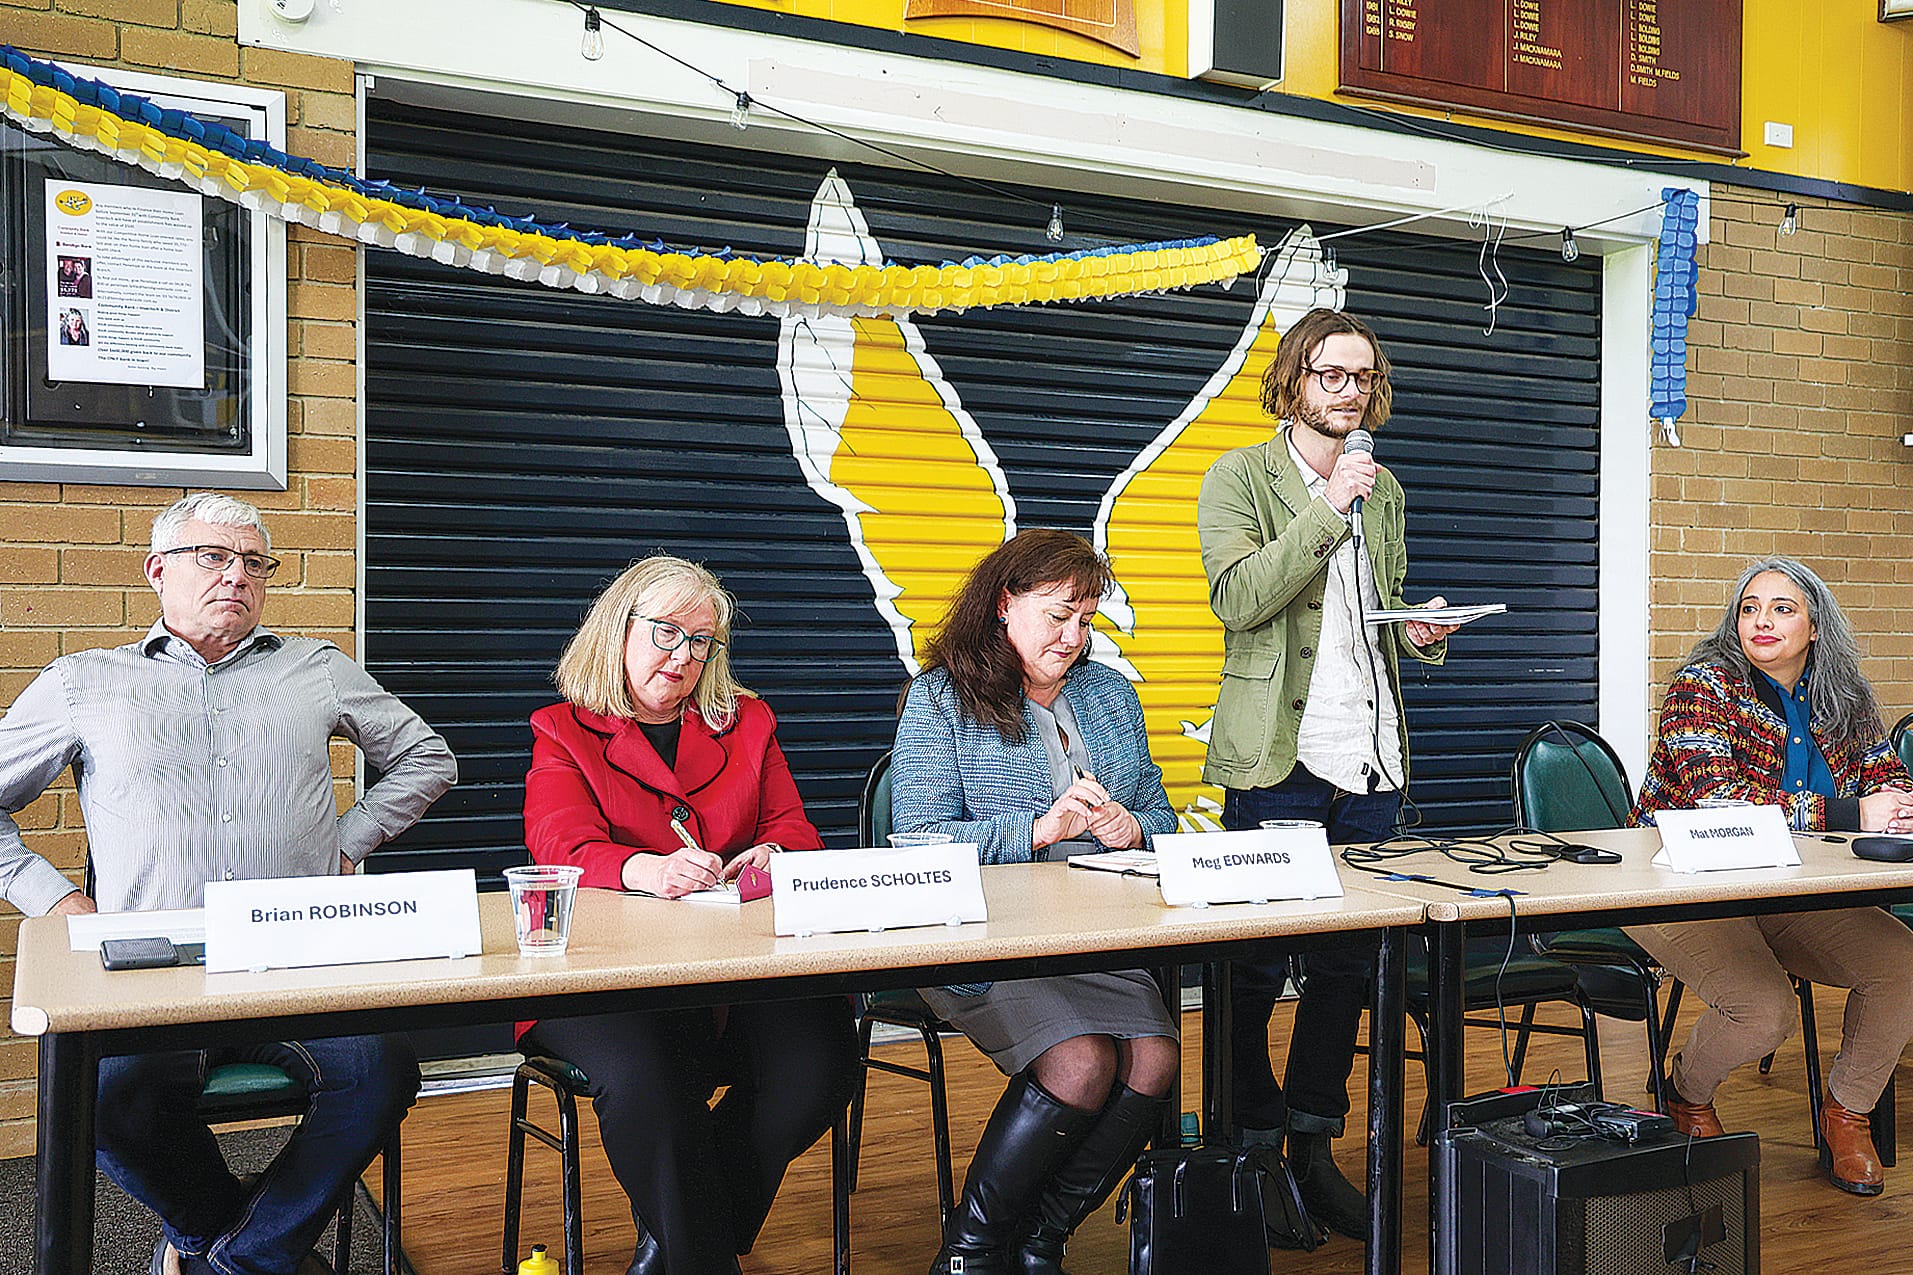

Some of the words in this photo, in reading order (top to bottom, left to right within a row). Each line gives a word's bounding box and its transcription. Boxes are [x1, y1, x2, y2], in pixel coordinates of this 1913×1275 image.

[1689, 829, 1710, 840] Mat
[1709, 826, 1754, 839] MORGAN
[1192, 857, 1222, 871] Meg
[1223, 852, 1291, 867] EDWARDS
[793, 876, 868, 892] Prudence
[870, 870, 952, 887] SCHOLTES
[251, 907, 303, 923] Brian
[309, 900, 418, 920] ROBINSON
